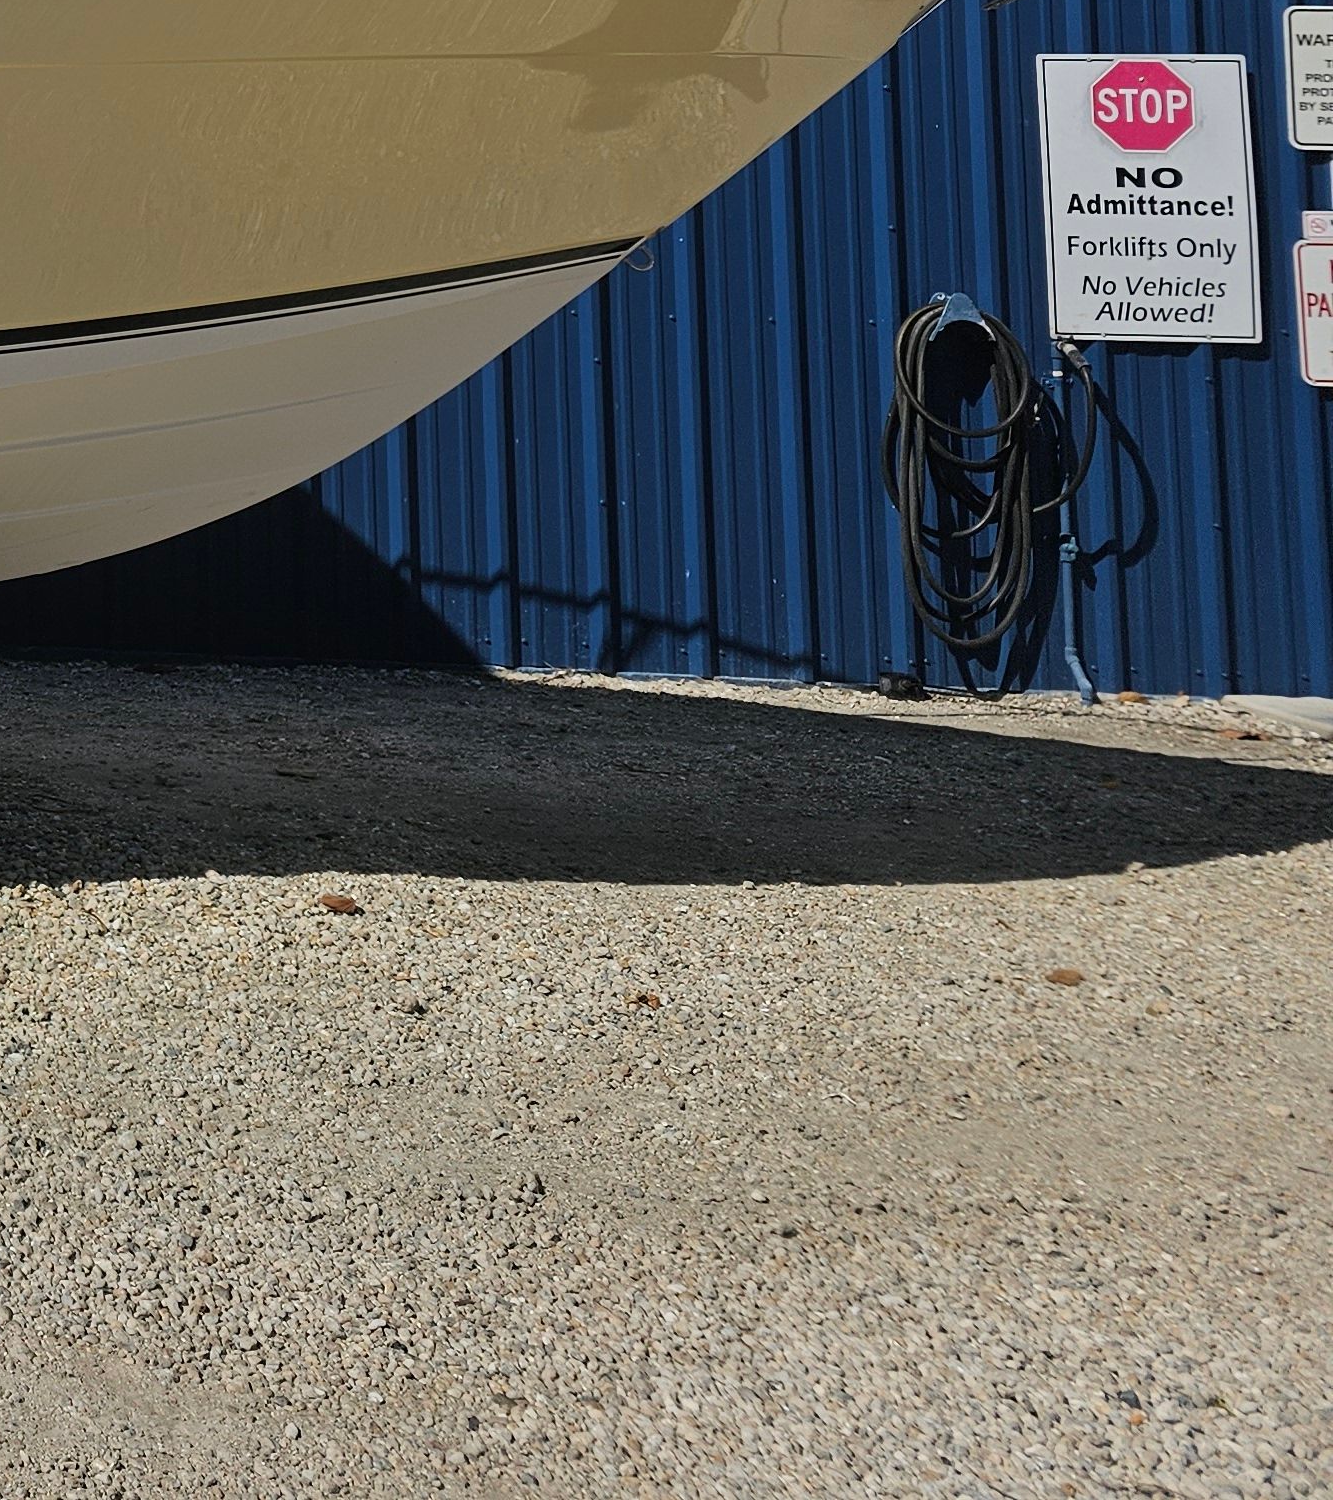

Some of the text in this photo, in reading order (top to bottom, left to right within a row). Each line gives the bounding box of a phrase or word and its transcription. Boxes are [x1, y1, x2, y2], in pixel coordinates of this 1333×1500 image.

[1097, 87, 1188, 124] STOP
[1115, 167, 1184, 189] NO
[1067, 193, 1234, 216] Admittance!
[1067, 235, 1237, 265] Forklifts Only
[1082, 275, 1227, 298] No Vehicles
[1095, 301, 1215, 323] Allowed!
